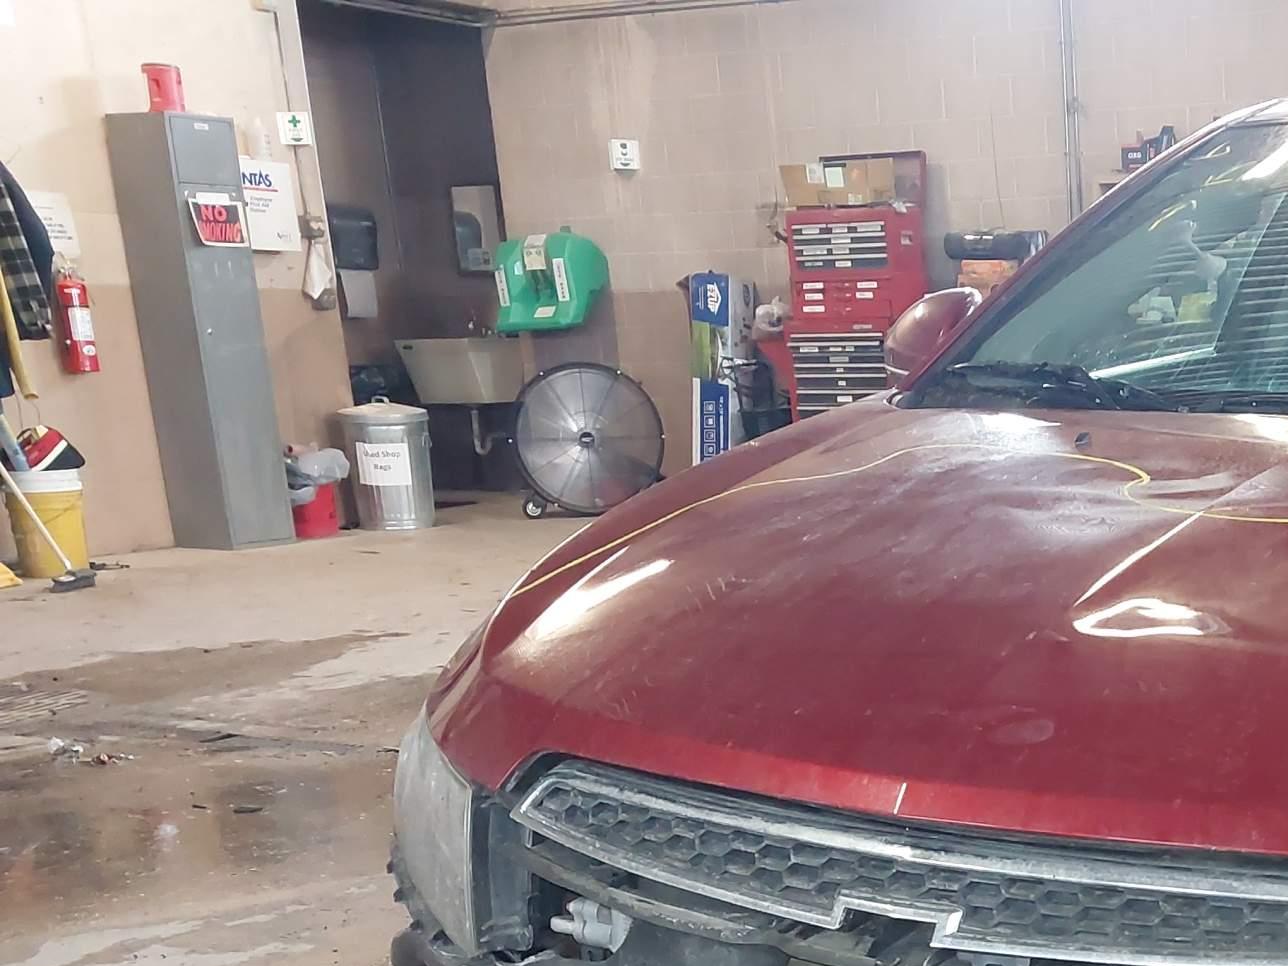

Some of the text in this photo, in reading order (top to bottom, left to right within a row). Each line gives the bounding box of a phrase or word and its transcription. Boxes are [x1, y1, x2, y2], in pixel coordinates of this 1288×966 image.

[241, 169, 273, 188] NTAS
[200, 204, 228, 221] NO
[199, 220, 242, 242] SMOKING
[381, 448, 401, 459] Shop
[373, 464, 392, 472] Rags
